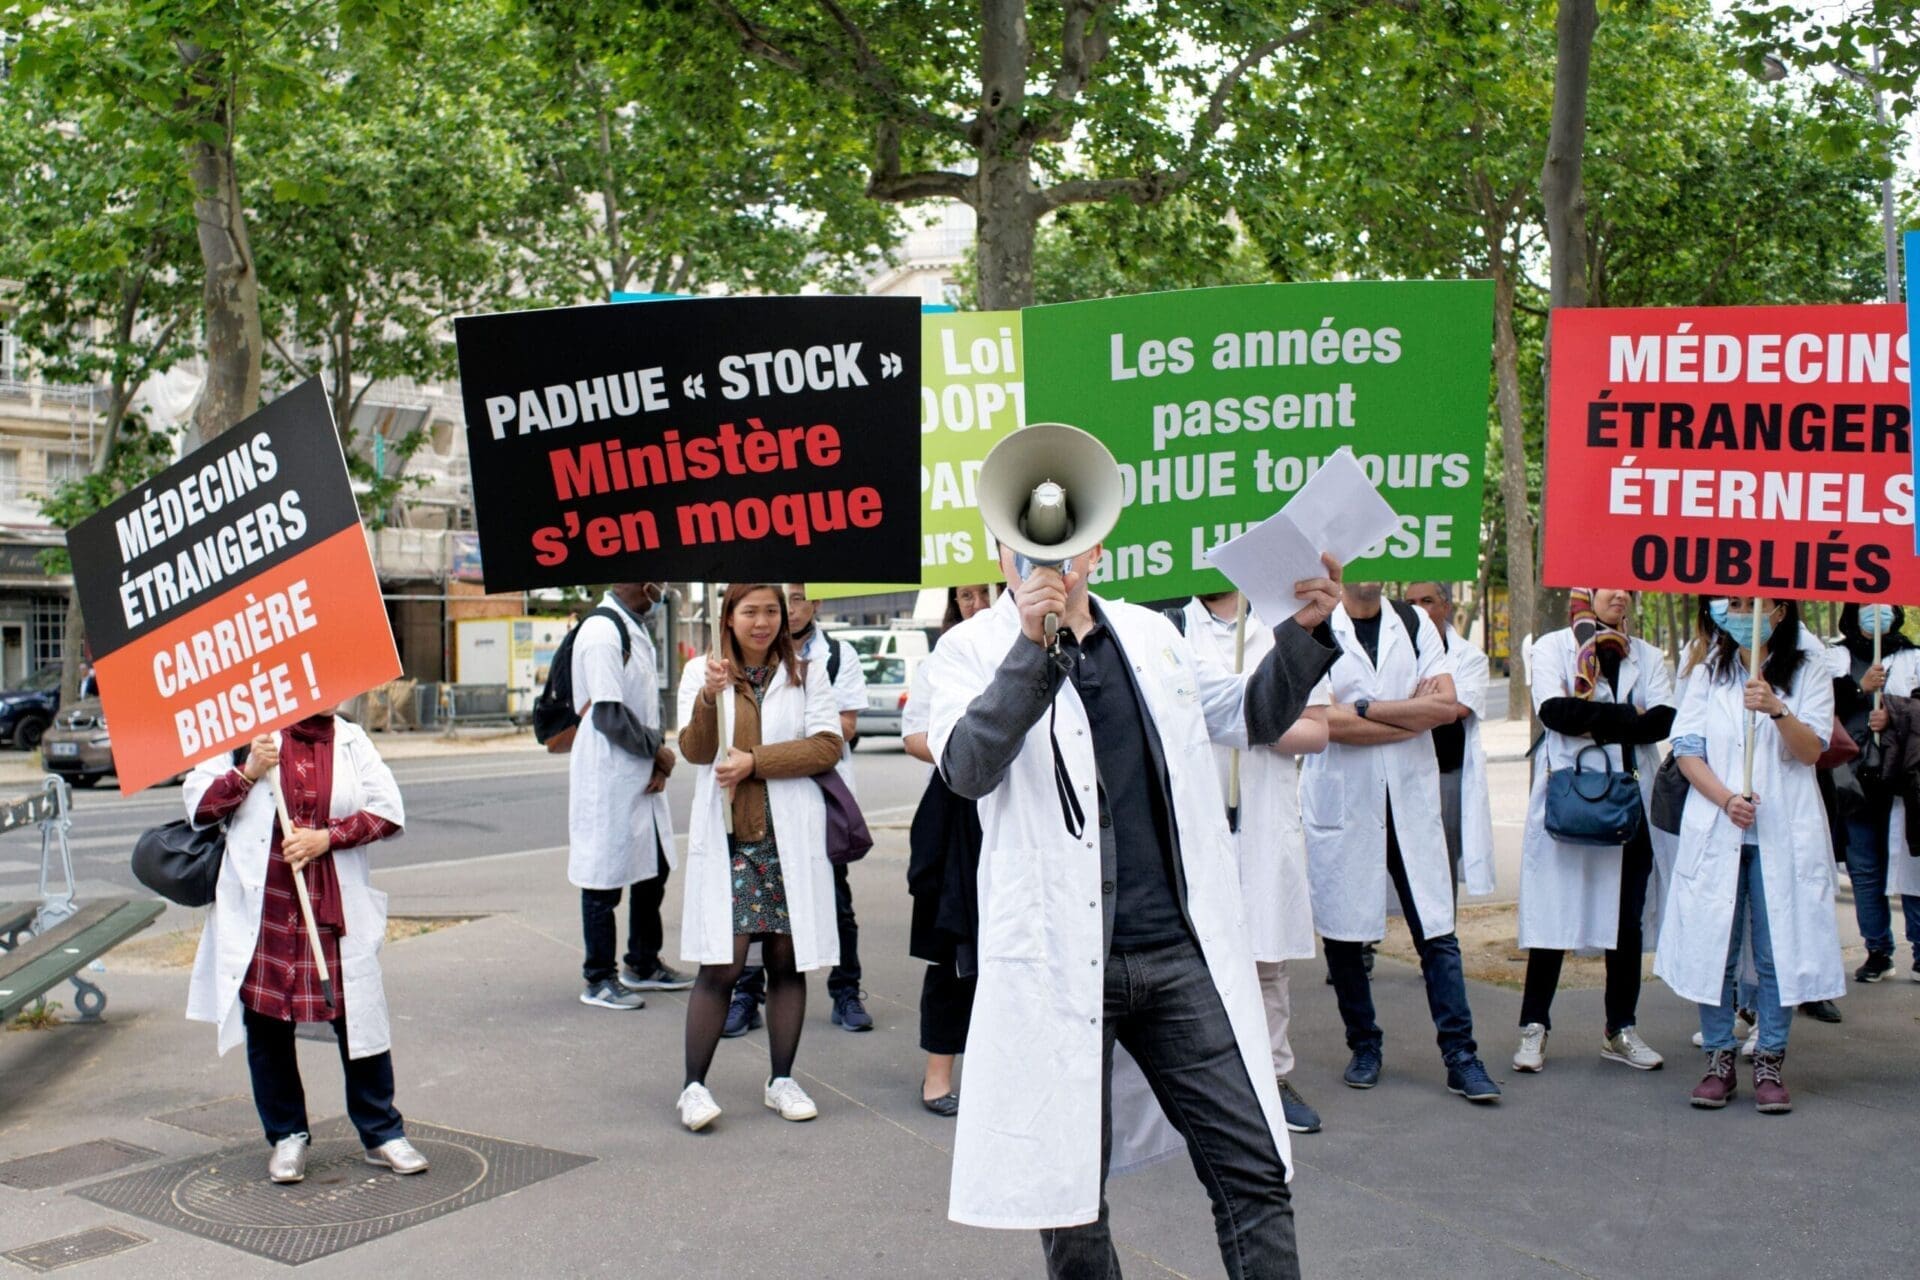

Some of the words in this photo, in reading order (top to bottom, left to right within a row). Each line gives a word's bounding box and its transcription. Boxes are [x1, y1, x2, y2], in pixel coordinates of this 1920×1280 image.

[941, 327, 1016, 375] Loi
[1110, 334, 1195, 380] Les
[1213, 317, 1402, 369] années
[486, 367, 669, 439] PADHUE
[719, 342, 868, 399] STOCK
[1154, 384, 1355, 450] passent
[116, 432, 280, 563] MÉDECINS
[550, 418, 840, 500] Ministère
[1609, 456, 1915, 525] ÉTERNELS
[119, 490, 307, 629] ÉTRANGERS
[532, 511, 659, 566] s’en
[677, 487, 882, 546] moque
[1631, 531, 1891, 593] OUBLIÉS
[153, 579, 317, 698] CARRIÈRE
[175, 663, 298, 758] BRISÉE
